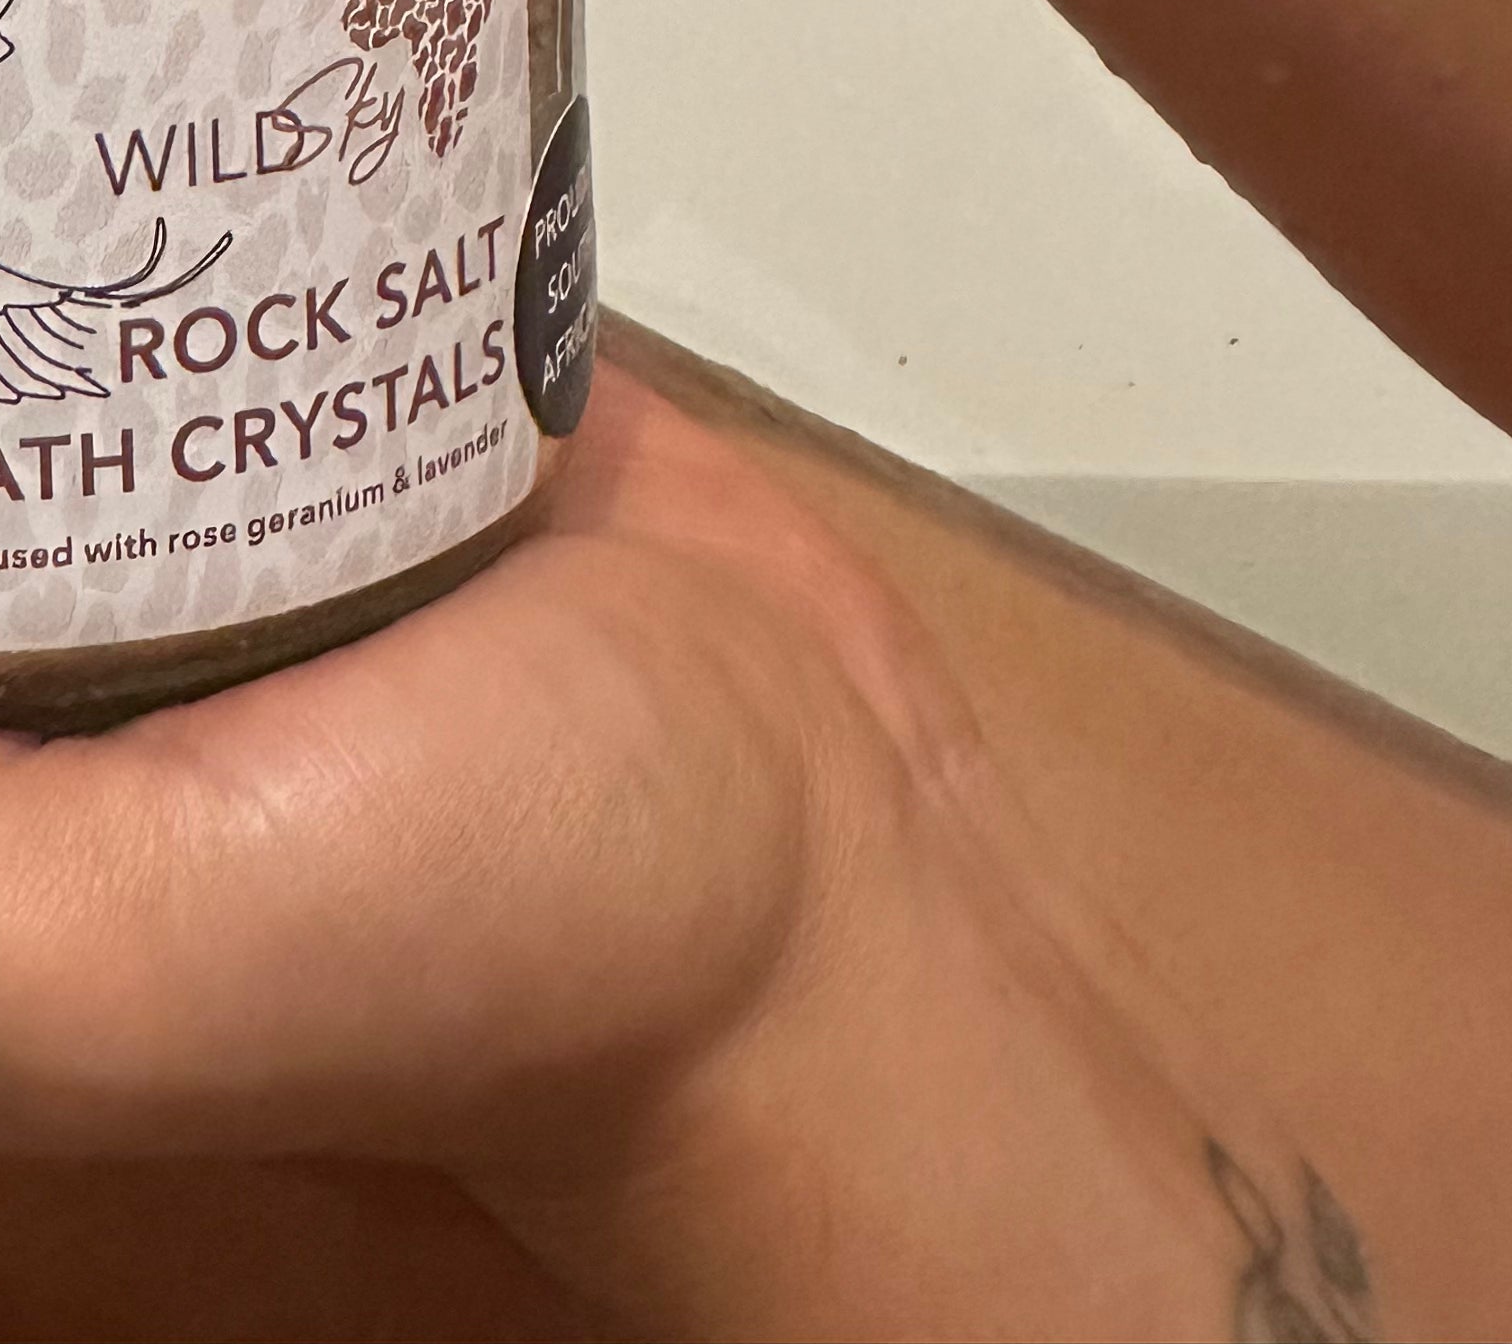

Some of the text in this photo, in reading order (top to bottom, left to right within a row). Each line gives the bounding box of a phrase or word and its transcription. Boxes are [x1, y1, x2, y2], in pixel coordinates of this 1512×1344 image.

[534, 166, 588, 260] PROU
[119, 214, 506, 383] ROCK SALT
[170, 319, 506, 482] CRYSTALS
[84, 527, 158, 564] with
[168, 522, 237, 555] rose
[247, 482, 385, 547] geranium
[392, 464, 411, 495] &
[417, 418, 509, 486] lavender
